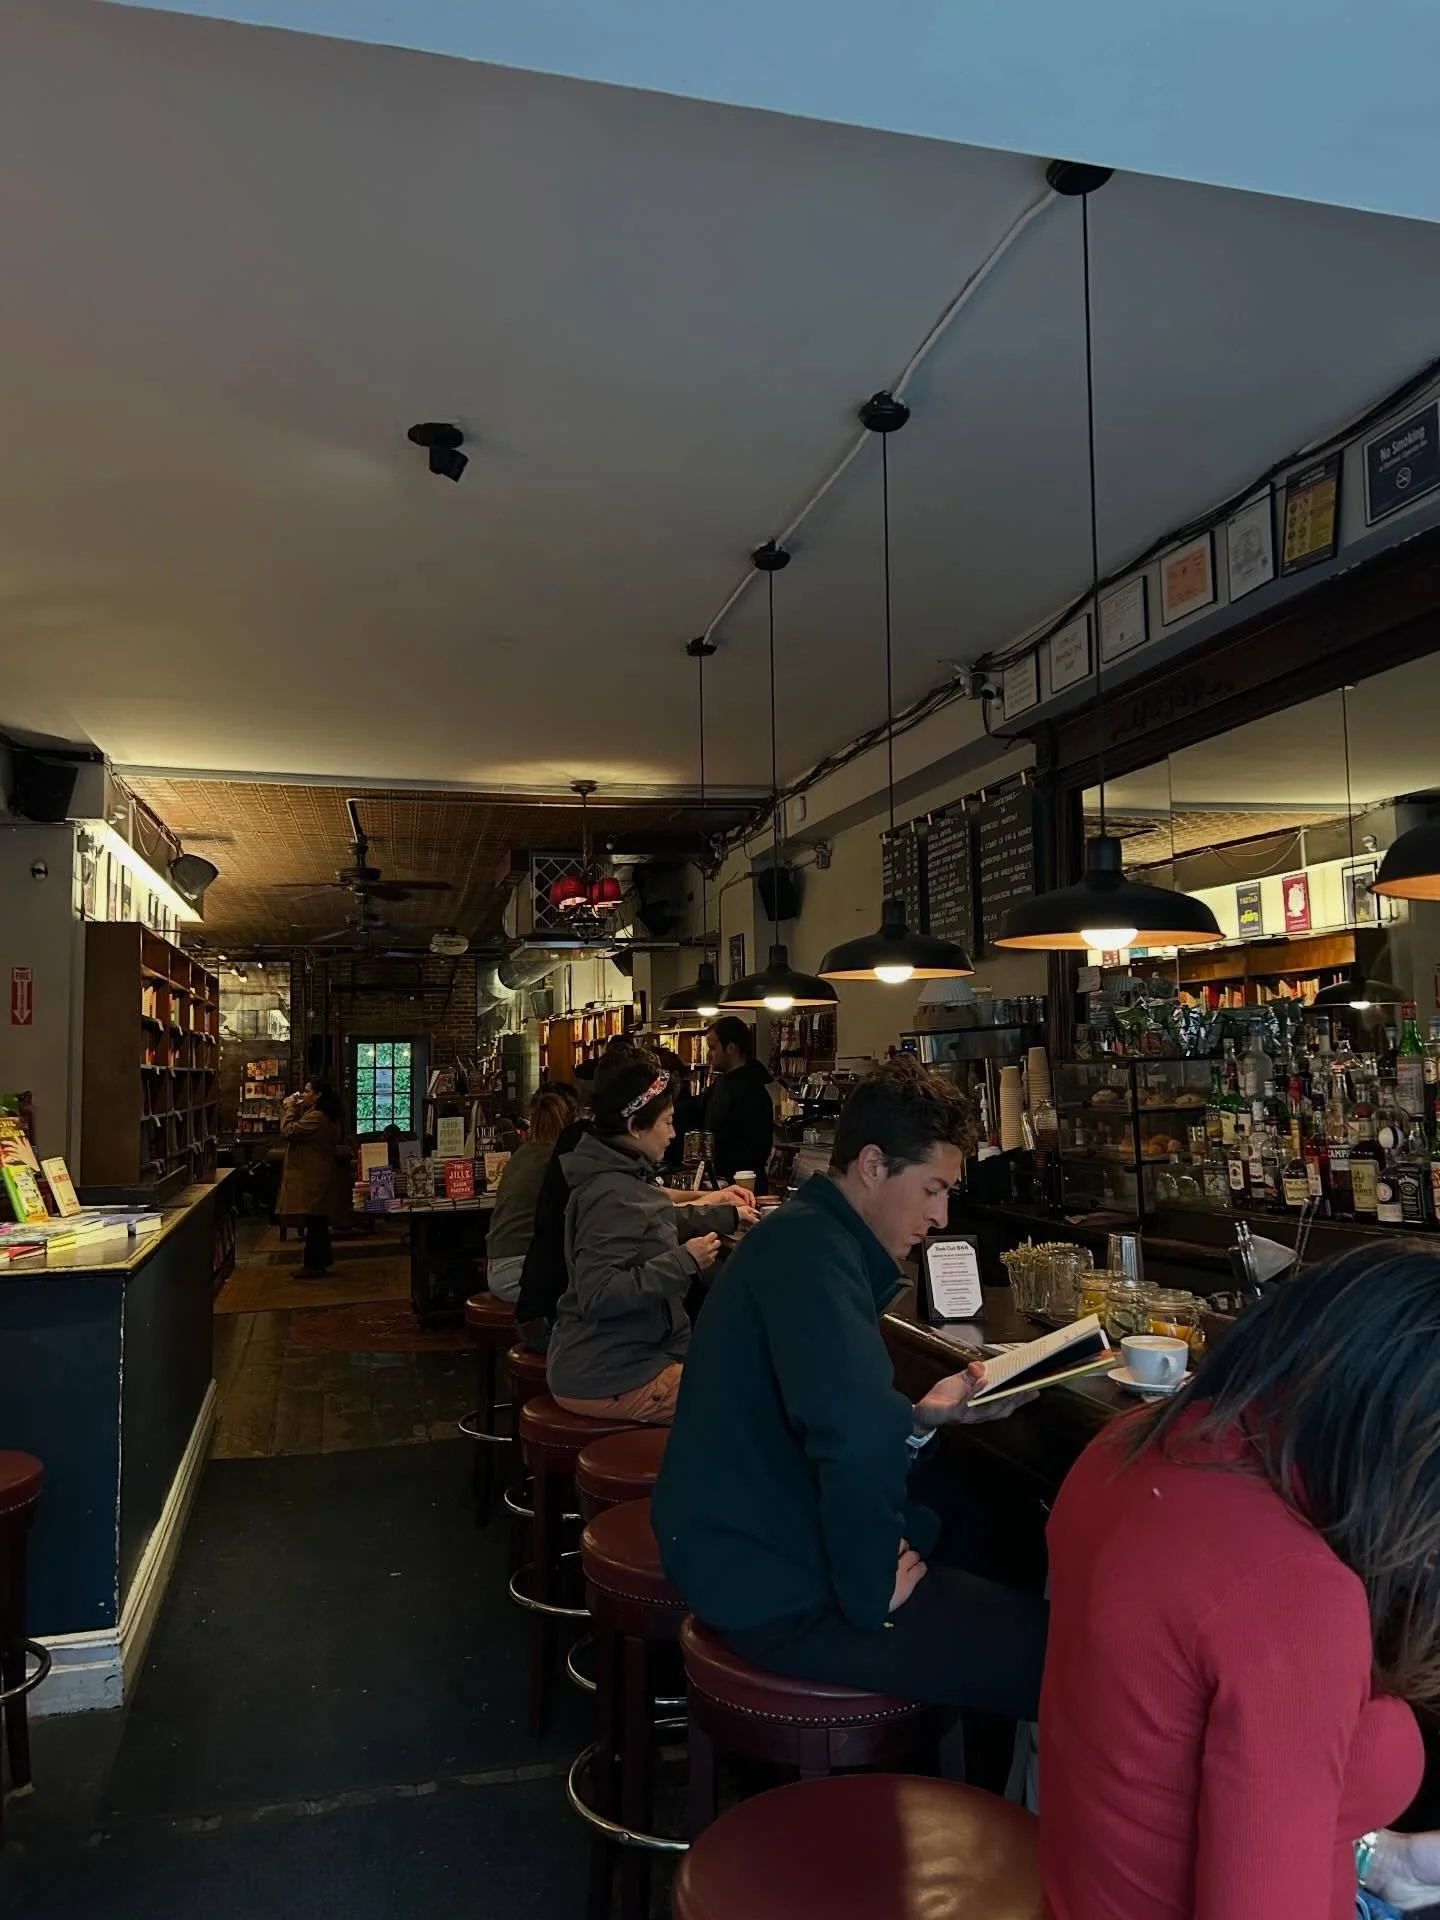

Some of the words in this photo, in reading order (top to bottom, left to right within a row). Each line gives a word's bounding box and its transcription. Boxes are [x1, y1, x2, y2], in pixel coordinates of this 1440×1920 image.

[1380, 448, 1391, 462] No
[1392, 427, 1425, 455] Smoking
[449, 1170, 471, 1180] JILLS
